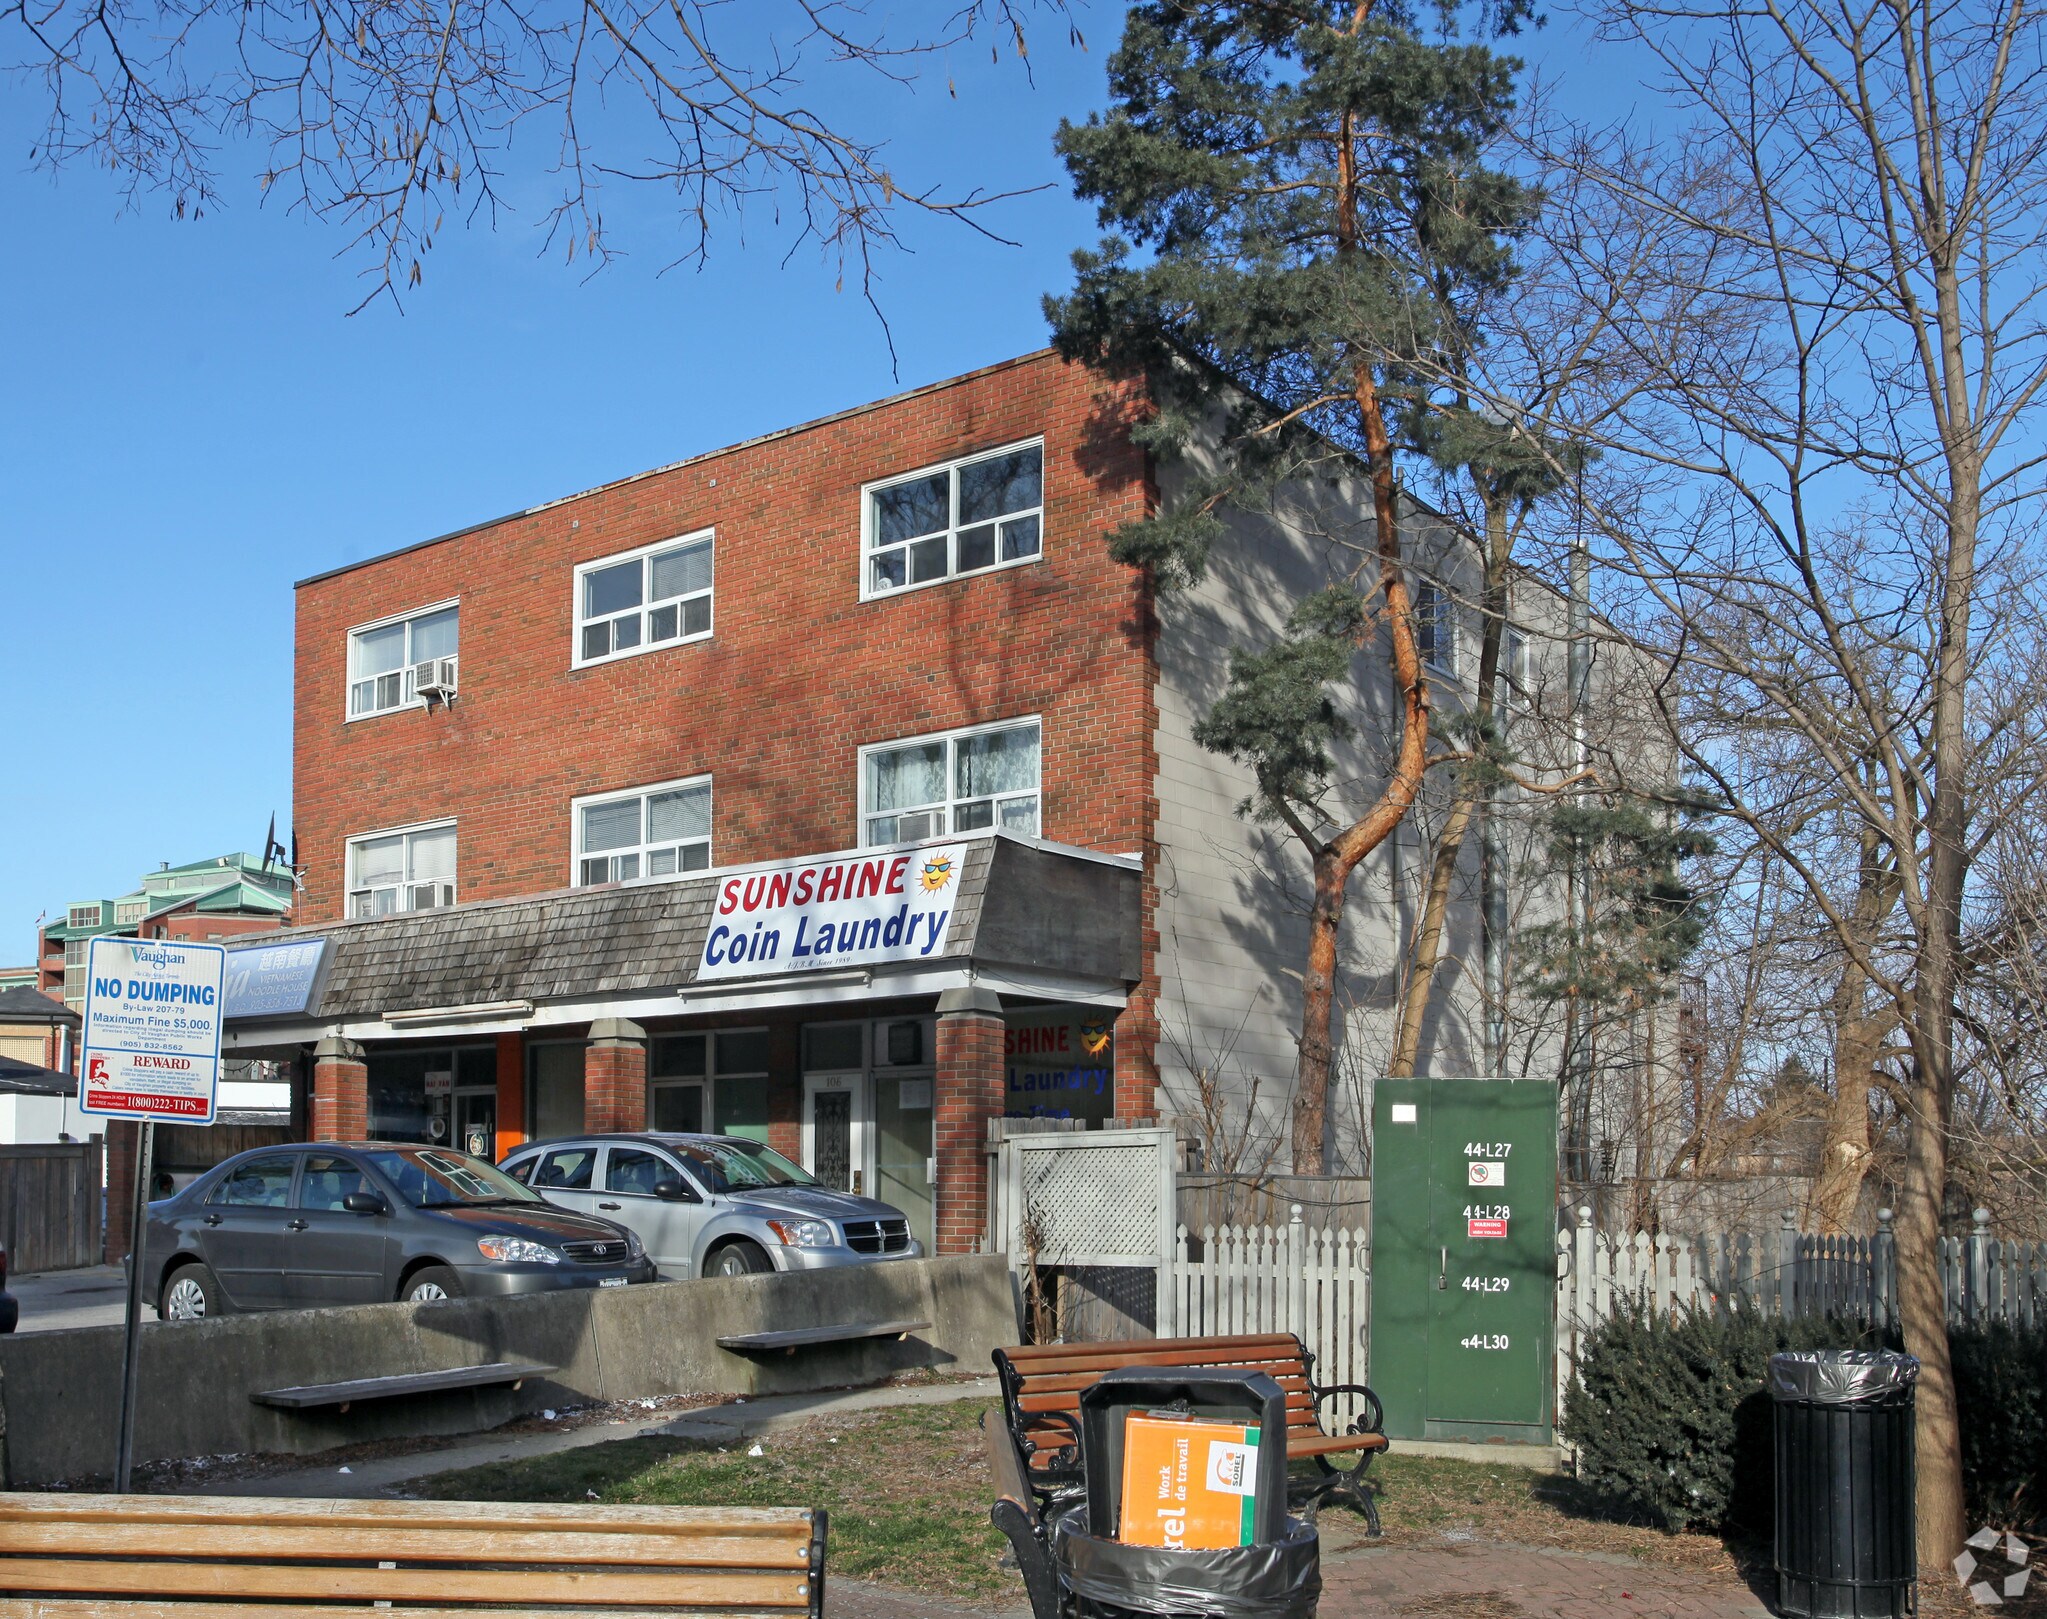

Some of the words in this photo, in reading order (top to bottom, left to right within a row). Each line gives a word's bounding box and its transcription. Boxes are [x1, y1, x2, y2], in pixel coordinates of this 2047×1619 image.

[719, 856, 911, 915] SUNSHINE
[705, 921, 780, 966] Coin
[792, 904, 949, 957] Laundry
[129, 946, 185, 971] Vaughan
[816, 958, 833, 967] Since
[260, 970, 304, 984] VIETNAMESE
[95, 977, 122, 998] NO
[127, 980, 214, 1005] DUMPING
[247, 984, 280, 996] NOODLE
[282, 981, 309, 993] HOUSE
[122, 1003, 153, 1013] By-Law
[156, 1005, 184, 1014] 207-79
[93, 1012, 144, 1024] Maximum
[147, 1016, 170, 1026] Fine
[173, 1018, 212, 1031] $5,000.
[119, 1040, 141, 1048] (905)
[144, 1042, 183, 1050] 832-8562
[1005, 1026, 1069, 1054] SHINE
[133, 1055, 190, 1070] REWARD
[1010, 1065, 1108, 1094] Laundry
[127, 1095, 196, 1112] 1(800)222-TIPS
[1463, 1142, 1512, 1158] 44-L27
[1463, 1205, 1510, 1220] 44-L28
[1461, 1276, 1510, 1292] 44-L29
[1460, 1334, 1509, 1350] 44-L30
[1176, 1438, 1189, 1483] travail
[1232, 1453, 1243, 1487] SOREL
[1157, 1465, 1171, 1500] Work
[1174, 1485, 1186, 1500] de
